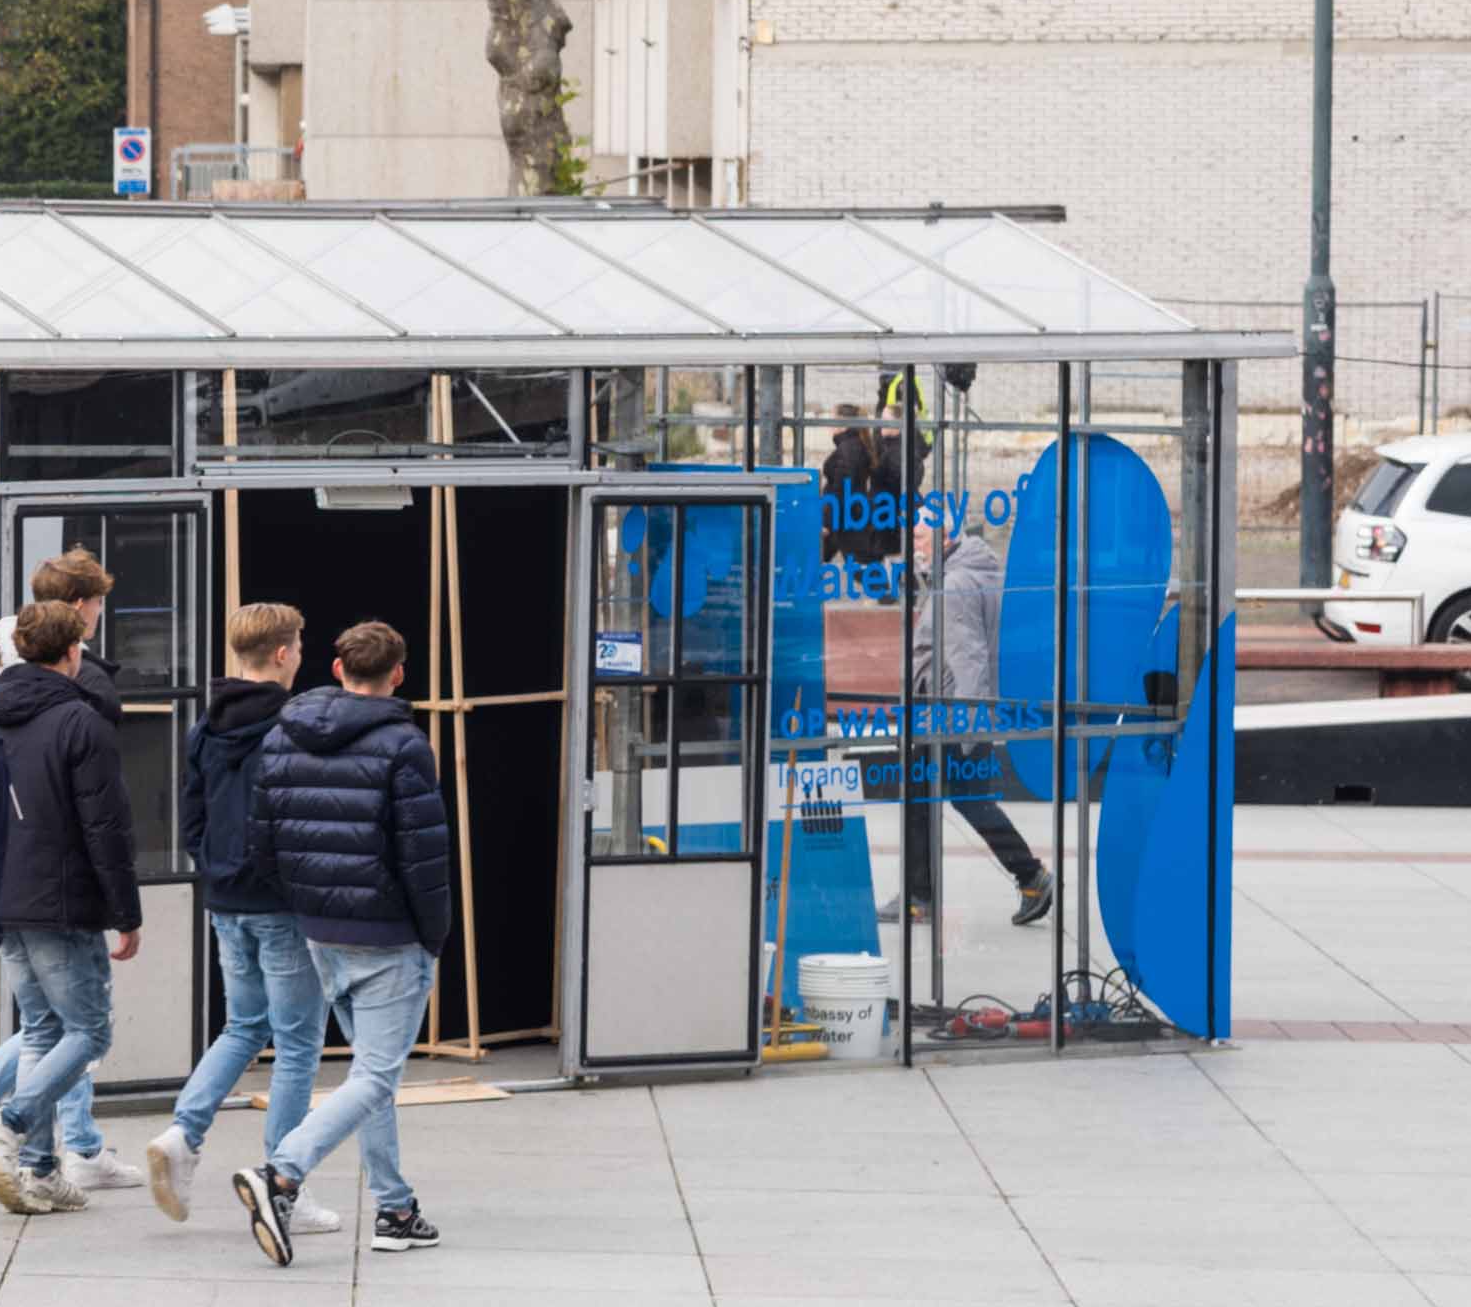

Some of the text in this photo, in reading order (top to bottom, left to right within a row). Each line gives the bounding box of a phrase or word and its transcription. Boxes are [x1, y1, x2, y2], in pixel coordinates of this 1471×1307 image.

[780, 706, 825, 740] OP
[777, 761, 860, 791] Ingang
[911, 756, 940, 783] de
[946, 749, 1003, 781] hoek
